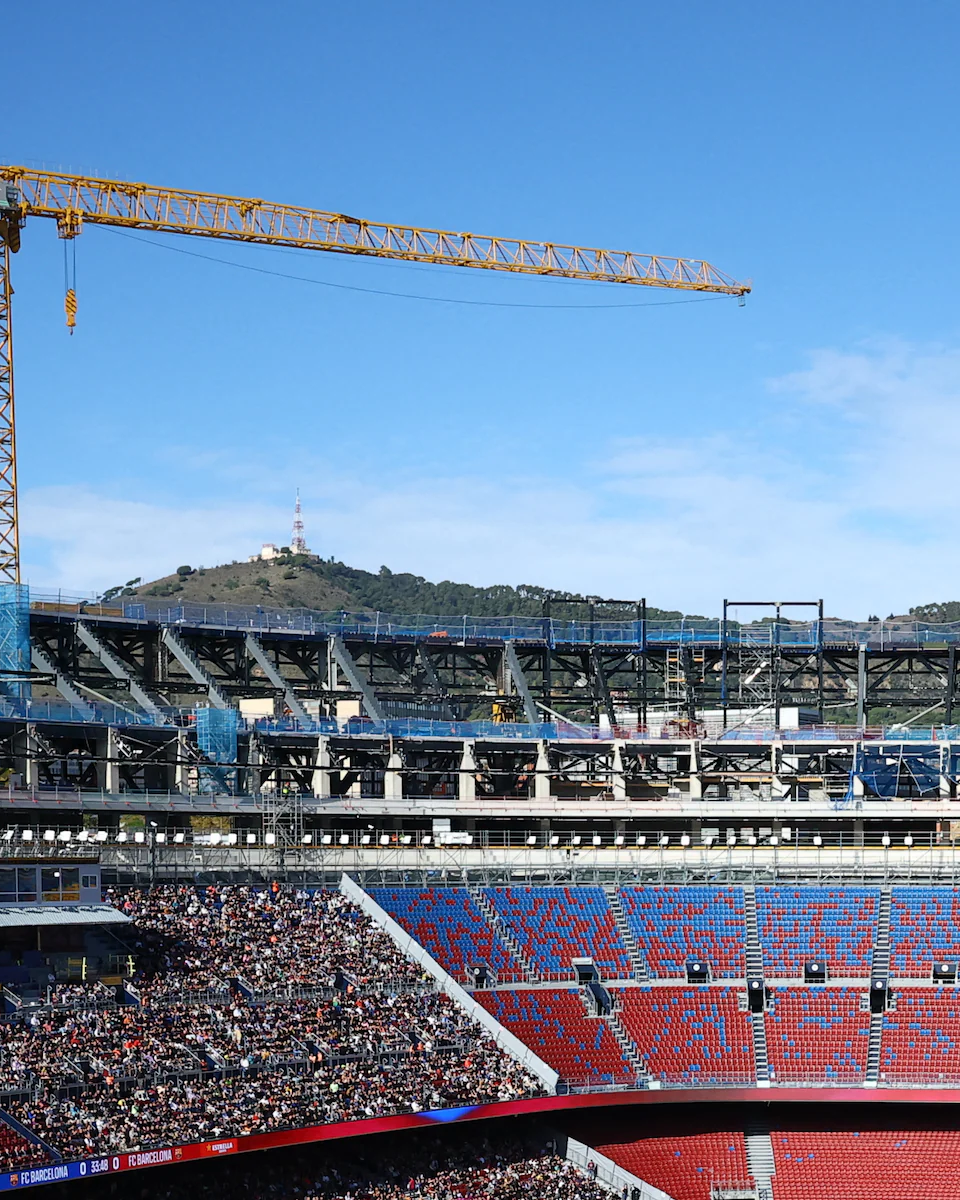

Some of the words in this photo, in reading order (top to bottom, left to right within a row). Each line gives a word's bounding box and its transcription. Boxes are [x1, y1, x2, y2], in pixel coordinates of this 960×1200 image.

[21, 1172, 30, 1184] FC
[30, 1165, 68, 1183] BARCELONA
[80, 1162, 87, 1175] 0
[91, 1159, 109, 1173] 33:48
[112, 1157, 120, 1170] 0
[128, 1154, 136, 1167] FC
[137, 1149, 172, 1165] BARCELONA
